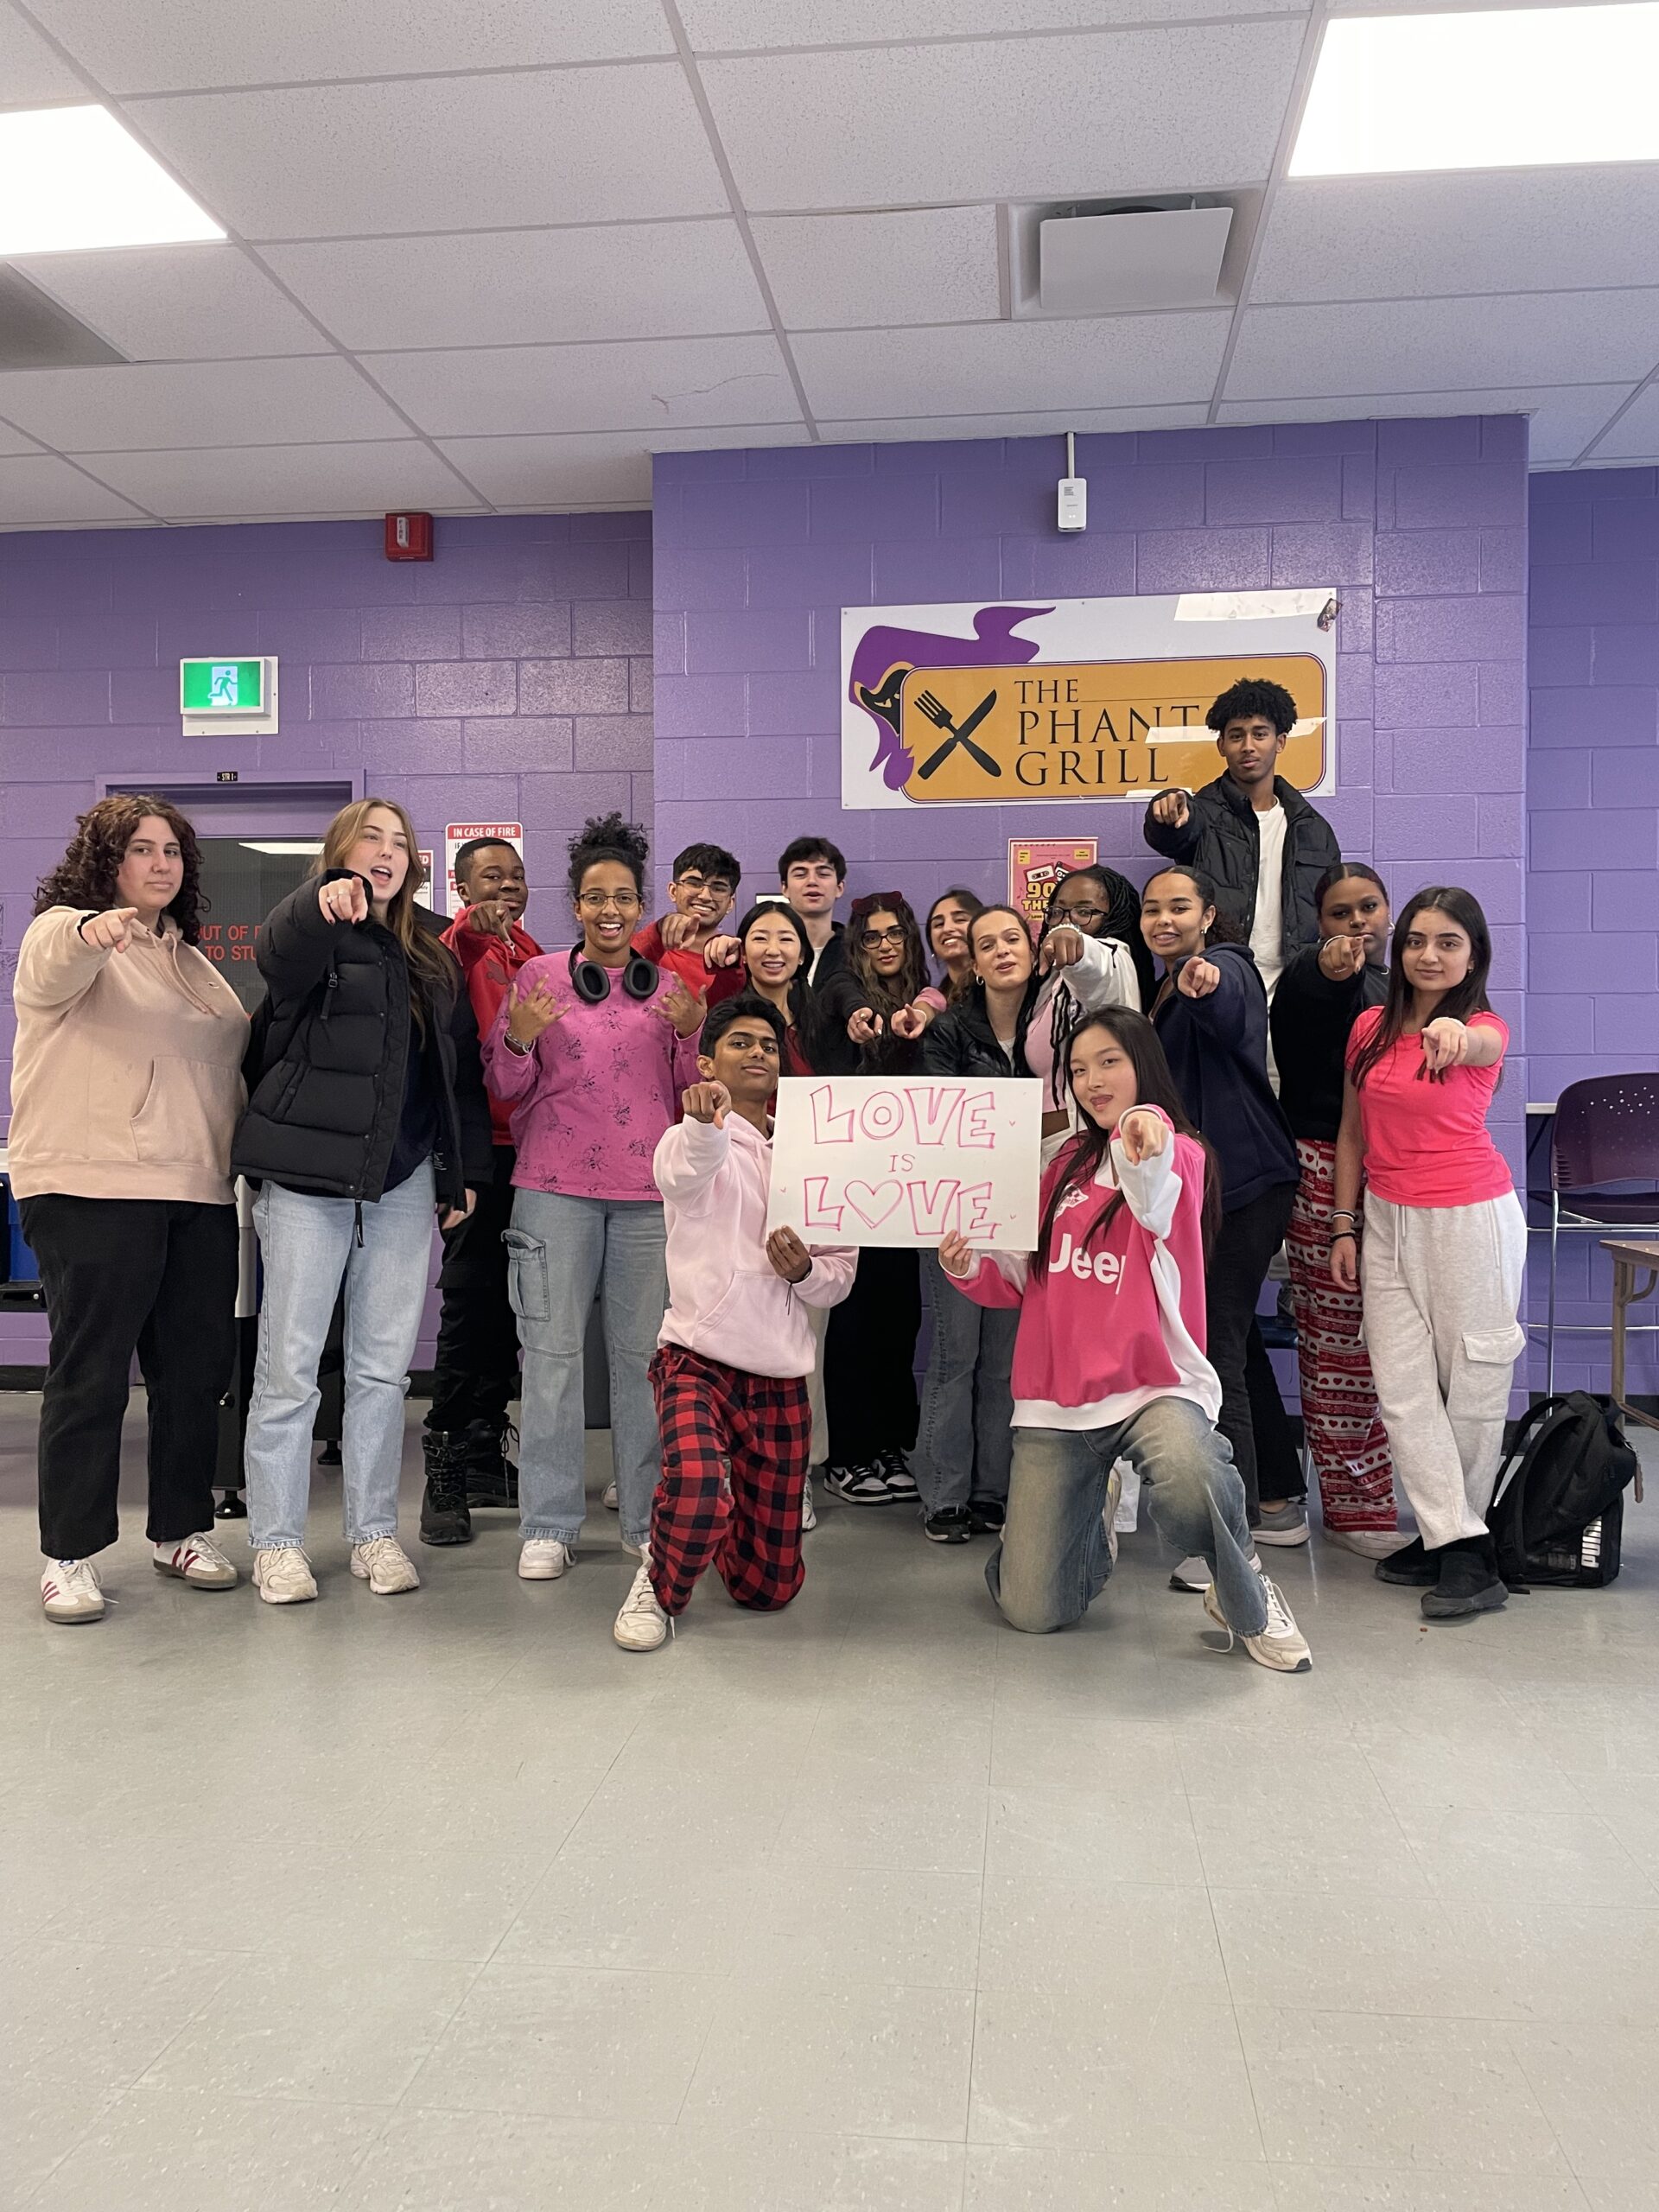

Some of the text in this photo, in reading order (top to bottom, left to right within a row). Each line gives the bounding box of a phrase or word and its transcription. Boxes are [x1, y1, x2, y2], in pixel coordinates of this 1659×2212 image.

[1014, 678, 1079, 704] THE
[1018, 704, 1200, 745] PHANT
[1015, 747, 1169, 786] GRILL
[453, 826, 517, 838] IN CASE OF FIRE
[1021, 899, 1050, 912] THE
[200, 925, 222, 942] UT
[228, 925, 250, 942] OF
[205, 944, 257, 961] TO STU
[809, 1084, 996, 1150] LOVE
[887, 1154, 917, 1173] IS
[1048, 1233, 1127, 1295] Jee
